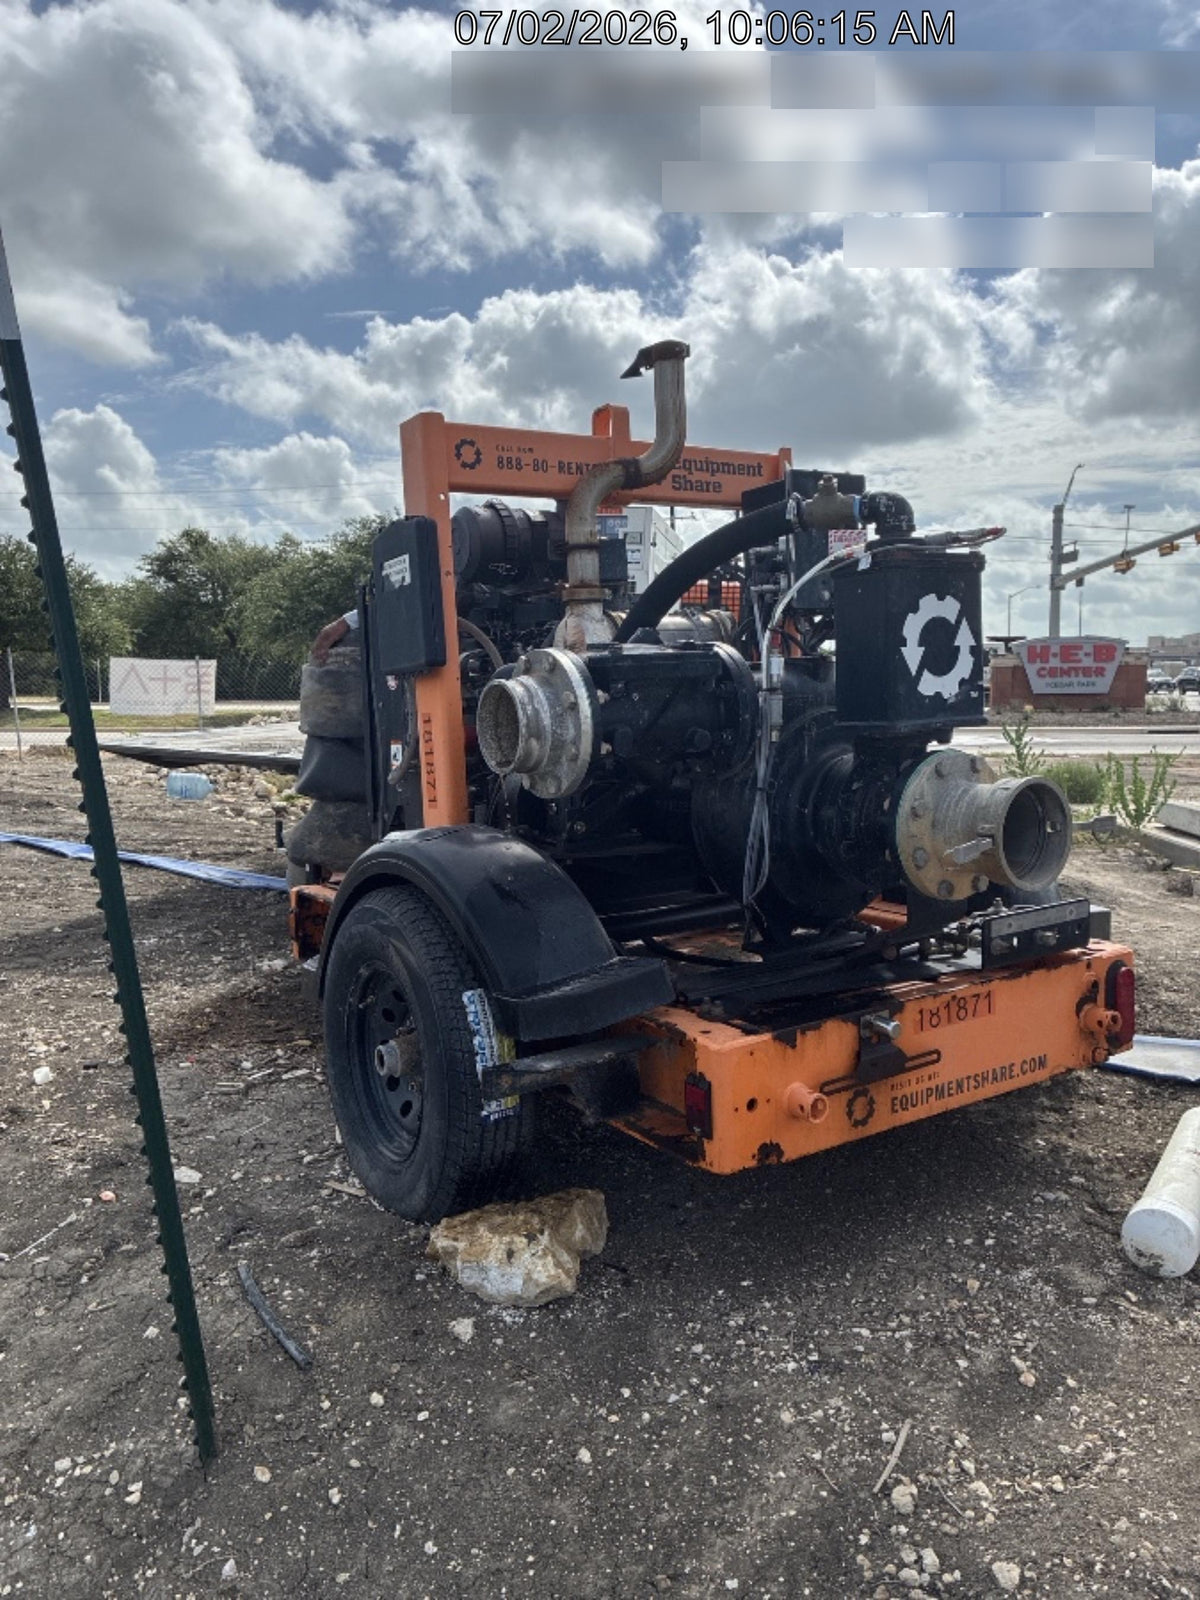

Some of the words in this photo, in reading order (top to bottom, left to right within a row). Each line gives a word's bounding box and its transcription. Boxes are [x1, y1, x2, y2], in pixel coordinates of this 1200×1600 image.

[671, 474, 723, 493] Share
[1036, 666, 1106, 678] CENTER
[918, 989, 992, 1032] 181871
[891, 1054, 1047, 1114] EQUIPMENTSHARE.COM
